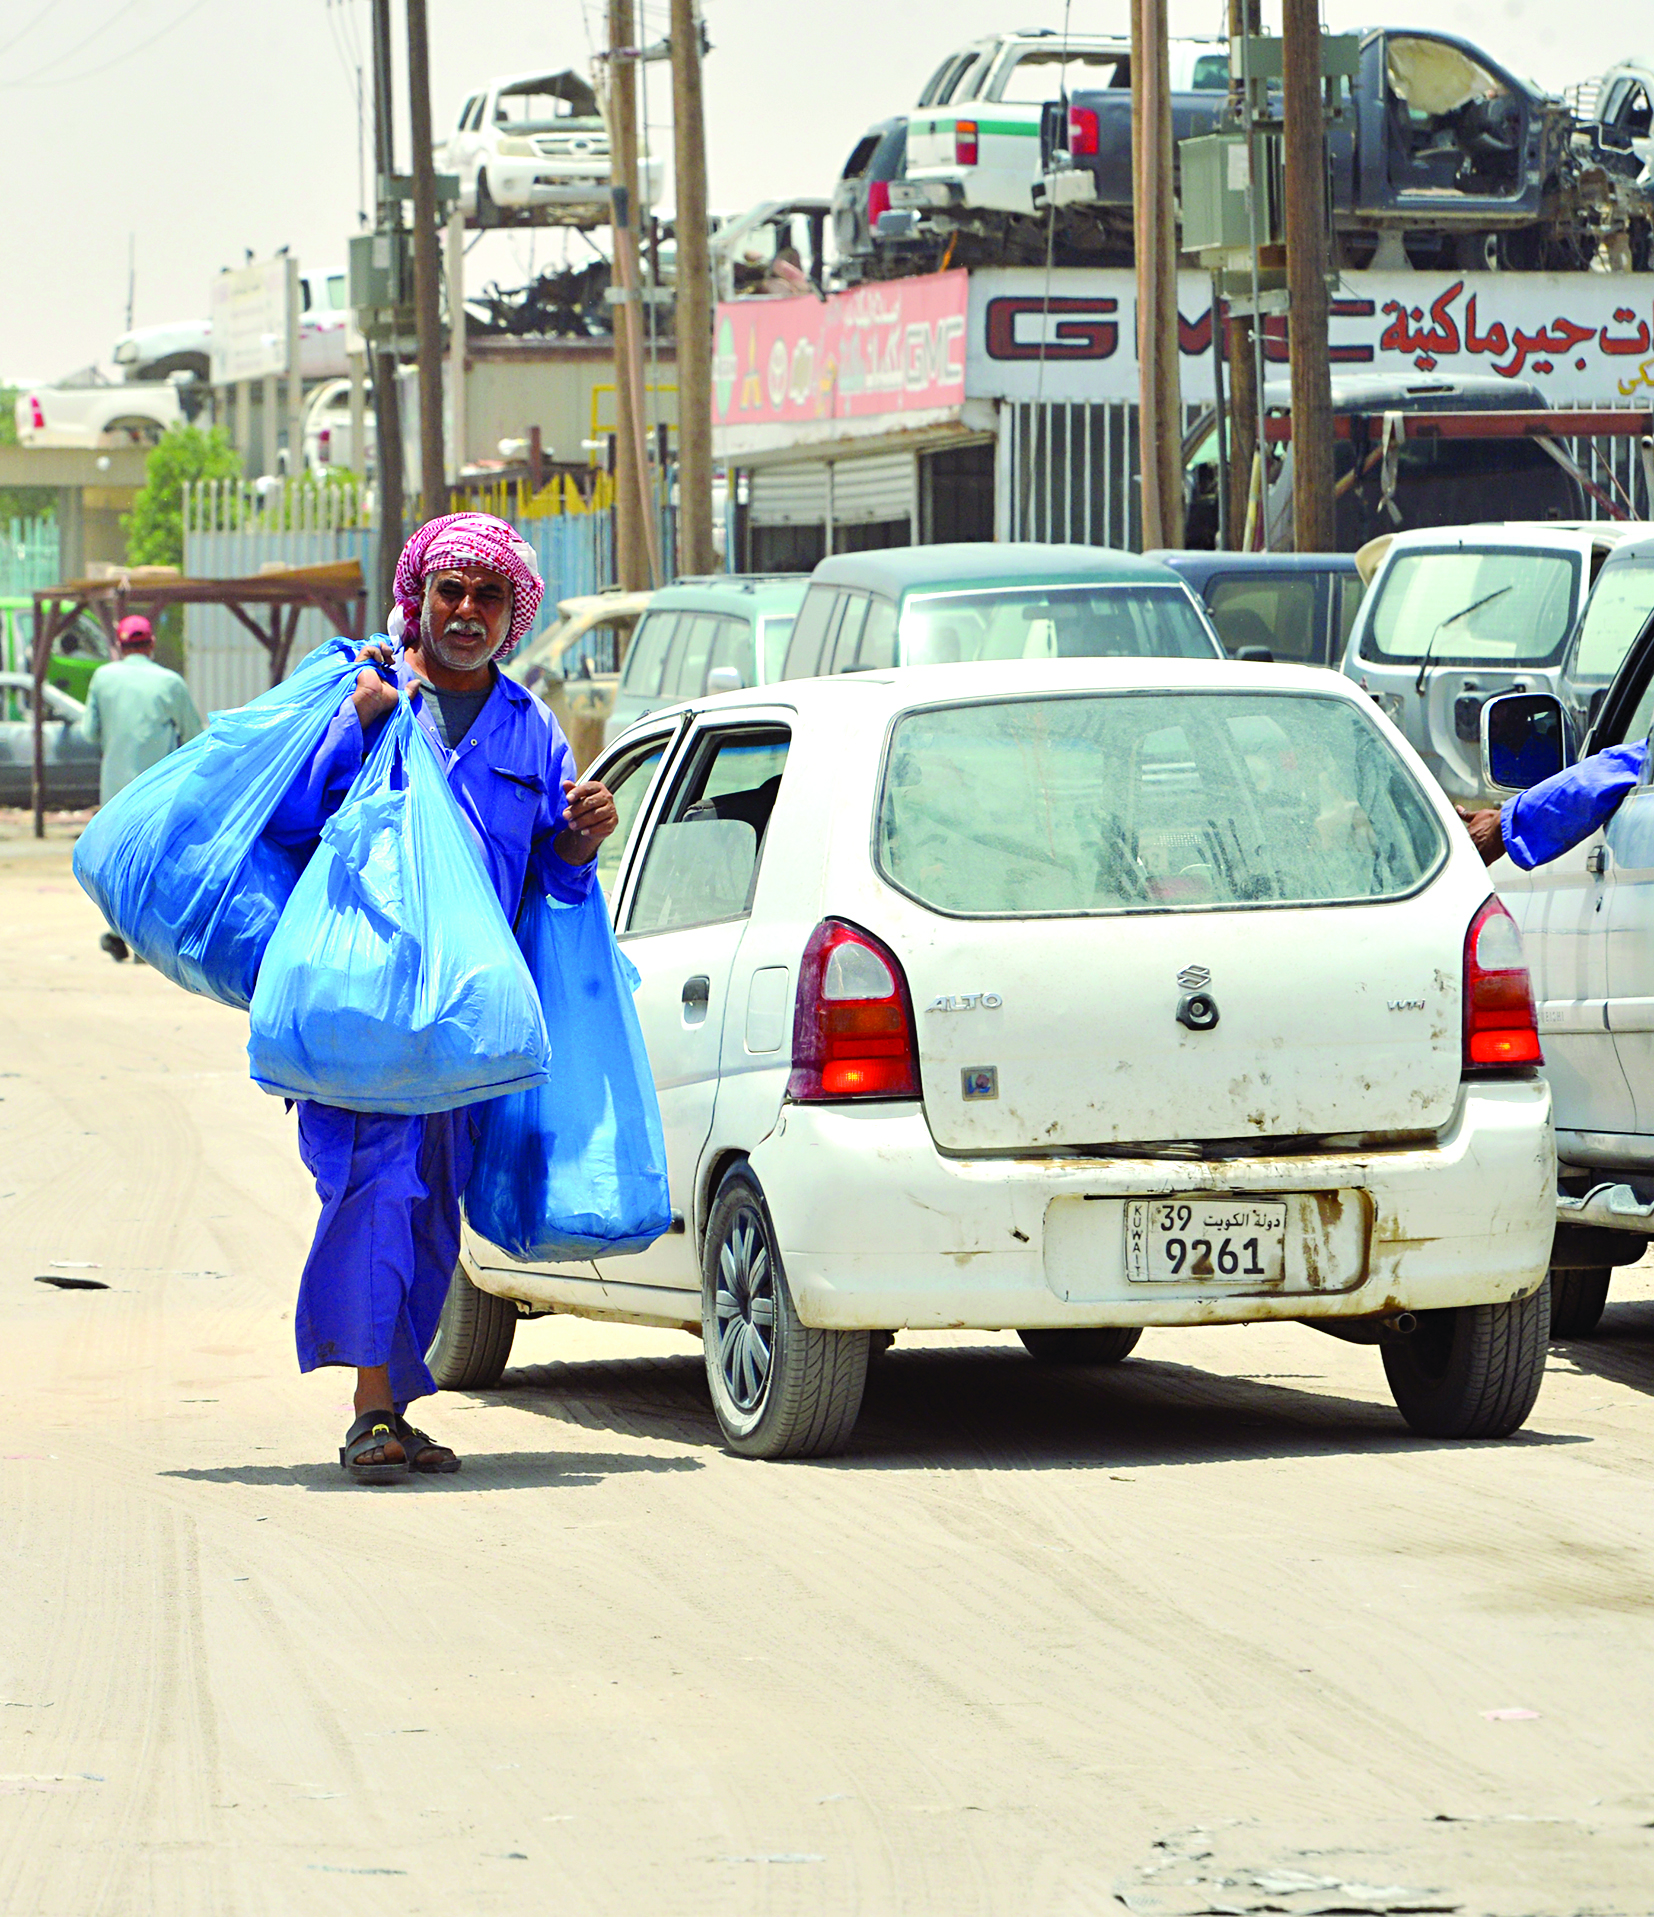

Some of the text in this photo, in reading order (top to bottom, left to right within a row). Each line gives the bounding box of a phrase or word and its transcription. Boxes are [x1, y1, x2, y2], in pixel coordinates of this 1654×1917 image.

[905, 315, 965, 391] GMC
[924, 992, 1003, 1013] ALTO
[1160, 1205, 1192, 1231] 39
[1203, 1211, 1281, 1232] دولة الكويت
[1132, 1205, 1143, 1278] KUWAIT
[1165, 1237, 1265, 1275] 9261
